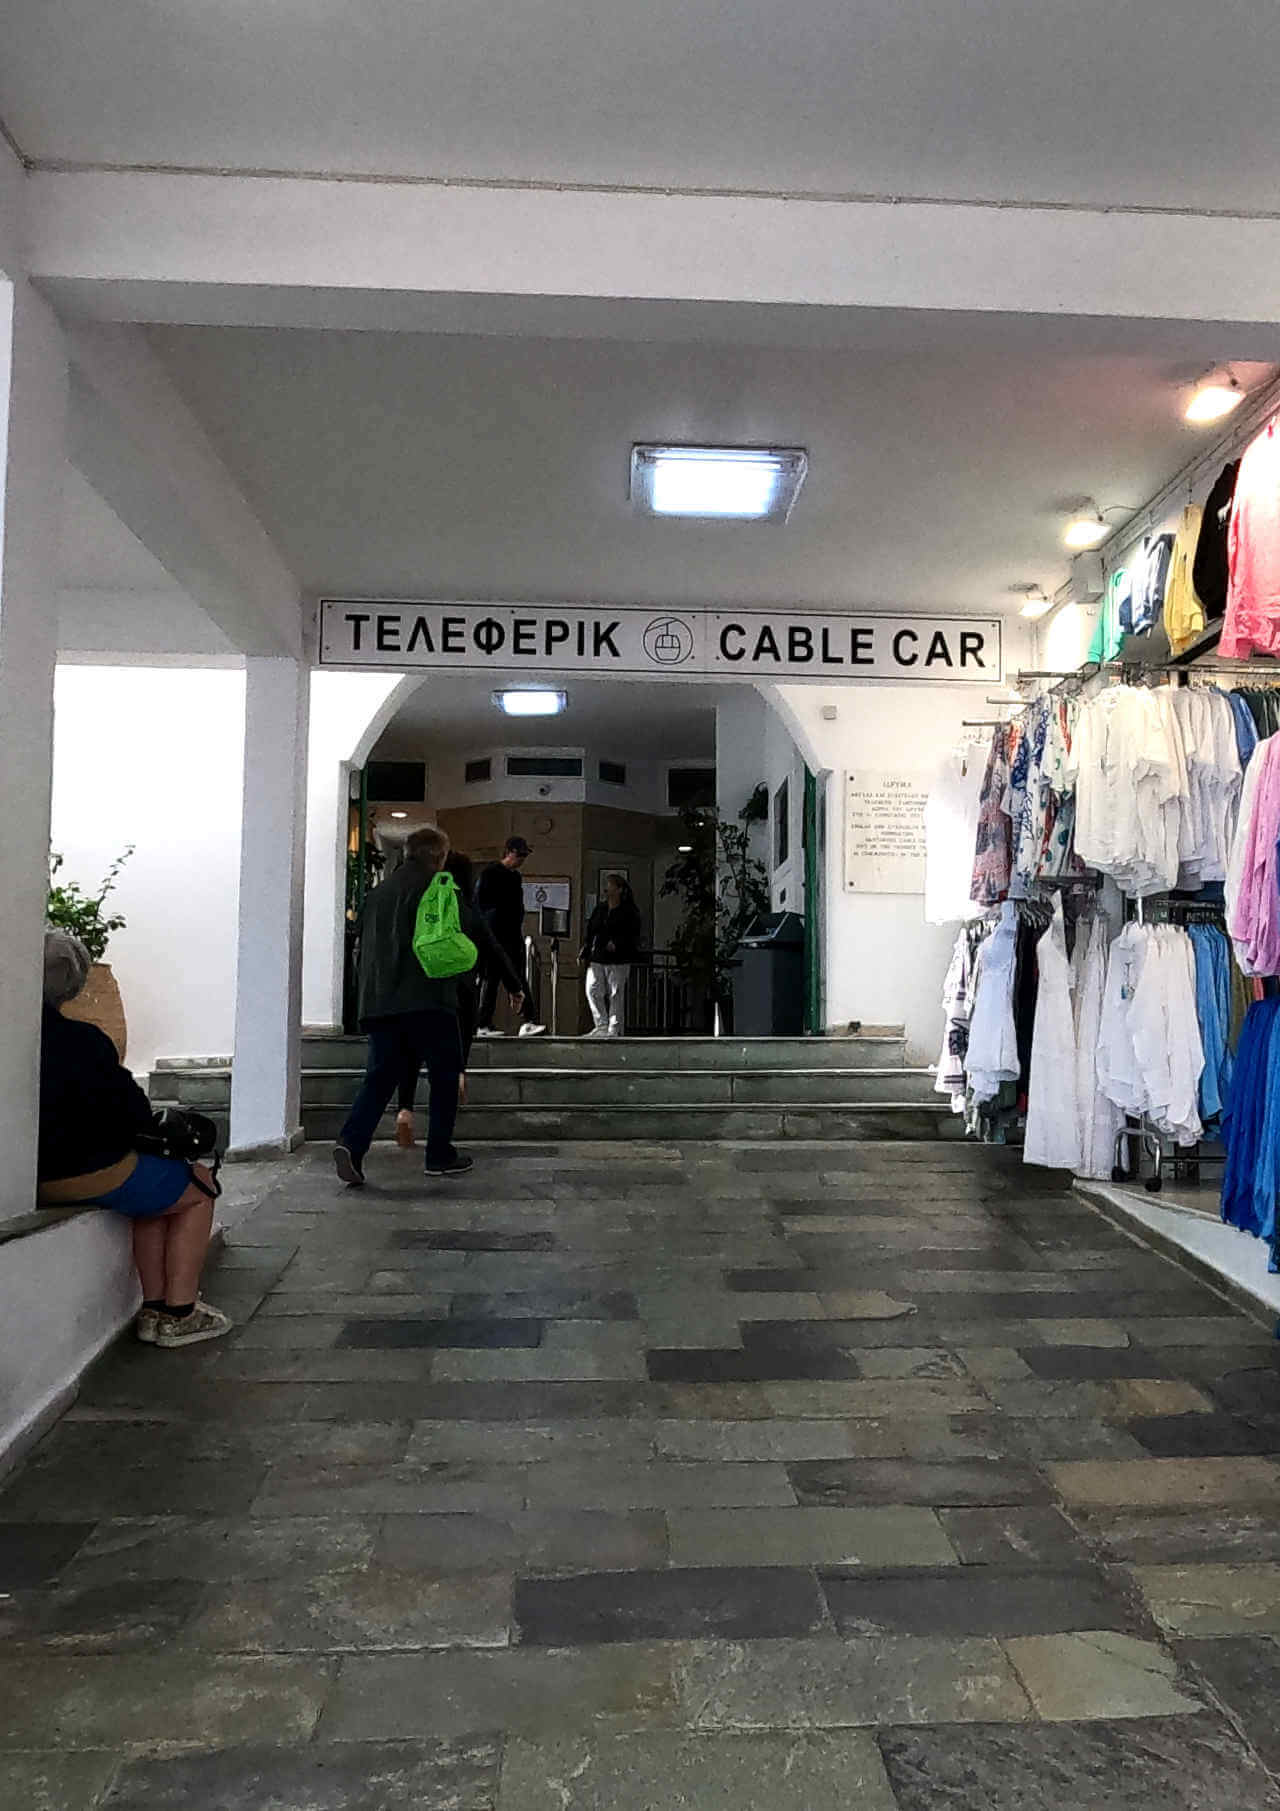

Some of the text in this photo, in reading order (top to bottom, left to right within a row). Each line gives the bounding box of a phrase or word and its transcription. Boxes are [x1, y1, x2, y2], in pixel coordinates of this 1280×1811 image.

[345, 613, 621, 657] ΤΕΛΕΦΕΡΙΚ
[719, 623, 985, 668] CABLE CAR
